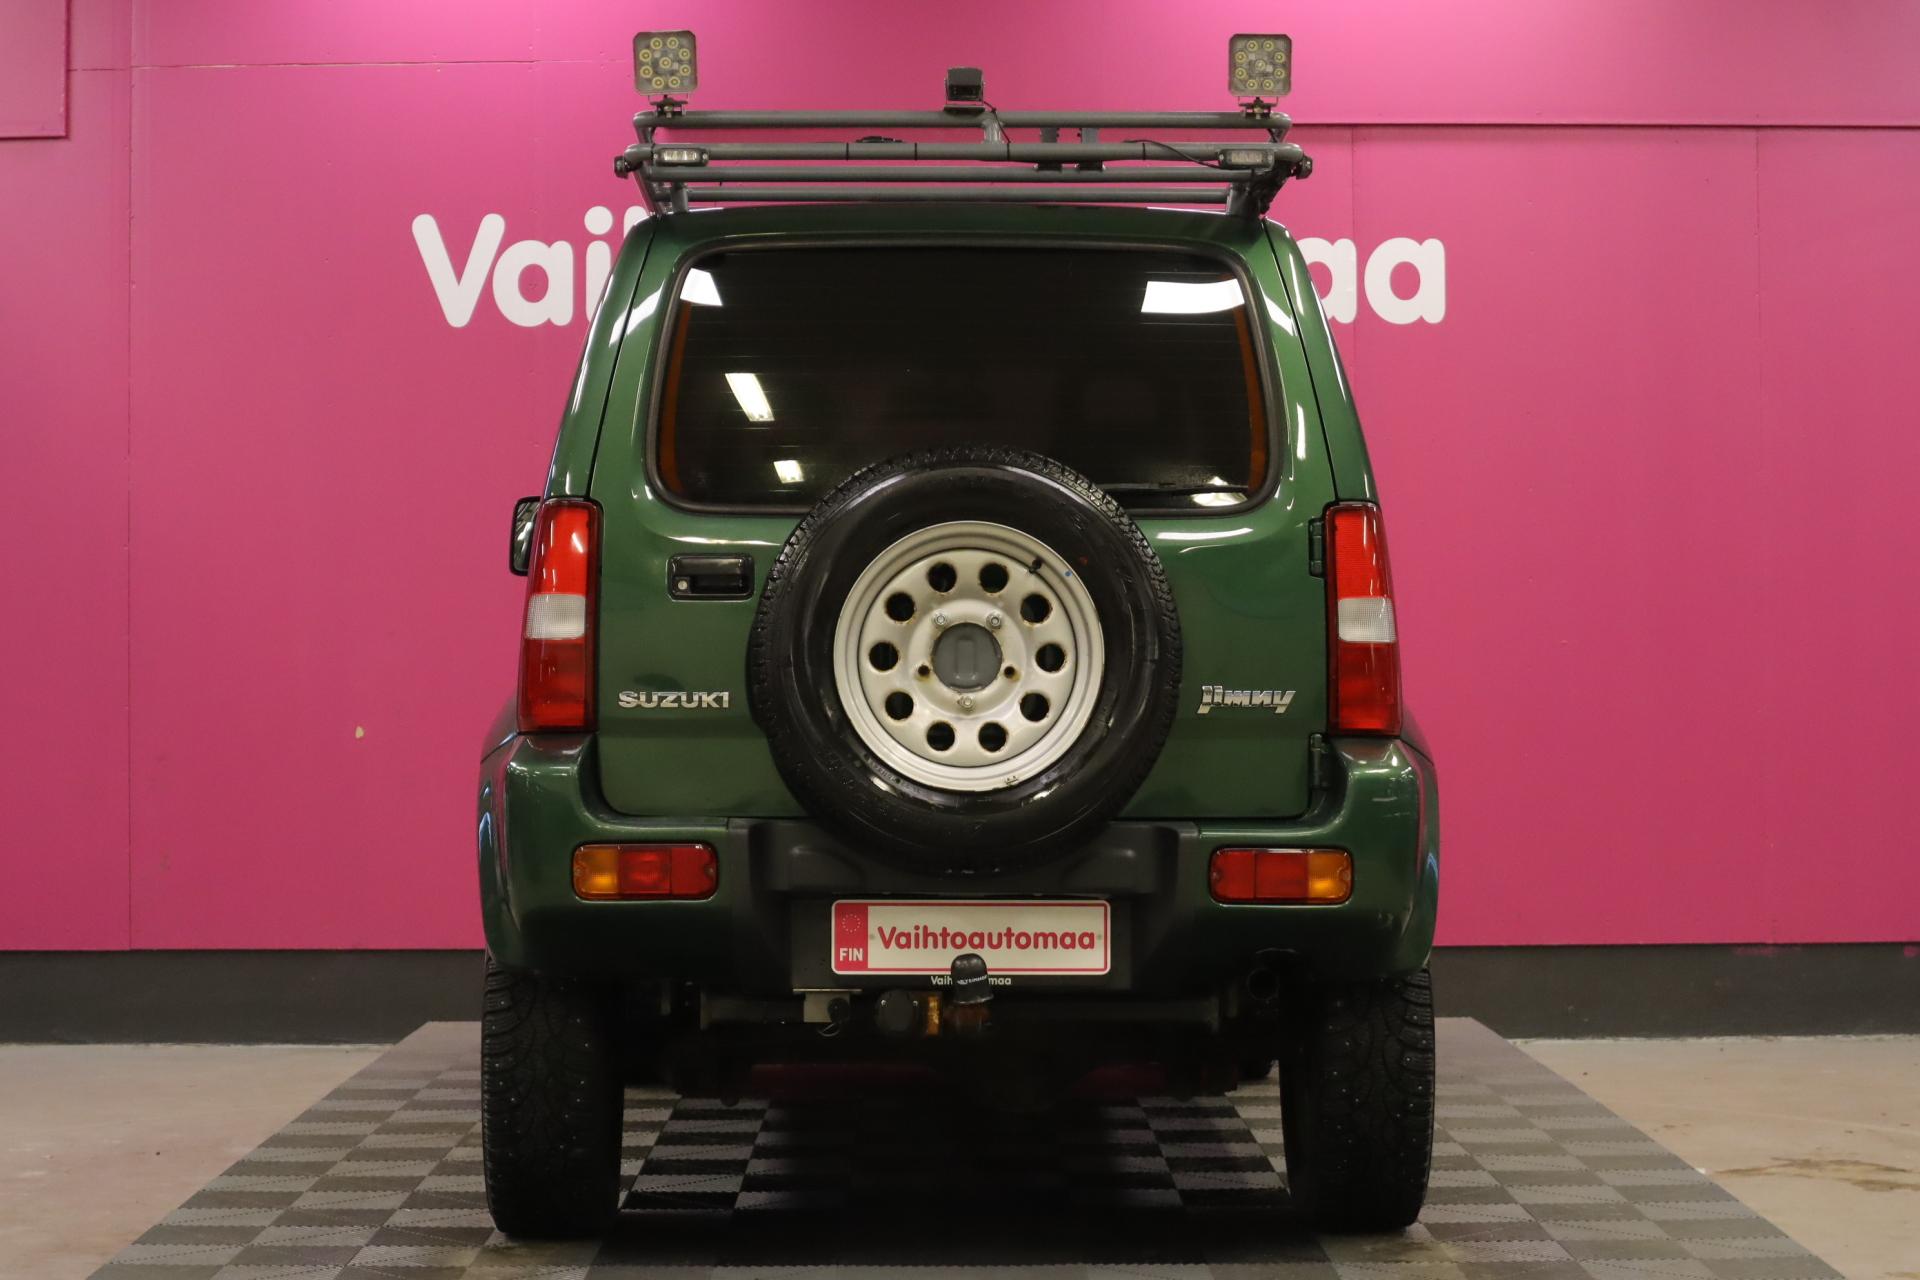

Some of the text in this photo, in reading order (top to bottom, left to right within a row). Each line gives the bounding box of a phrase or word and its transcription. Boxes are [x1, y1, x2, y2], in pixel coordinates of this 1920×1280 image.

[411, 205, 649, 328] Vai
[618, 691, 729, 708] SUZUKI
[877, 925, 1095, 950] Vaihtoautomaa
[839, 947, 864, 962] FIN
